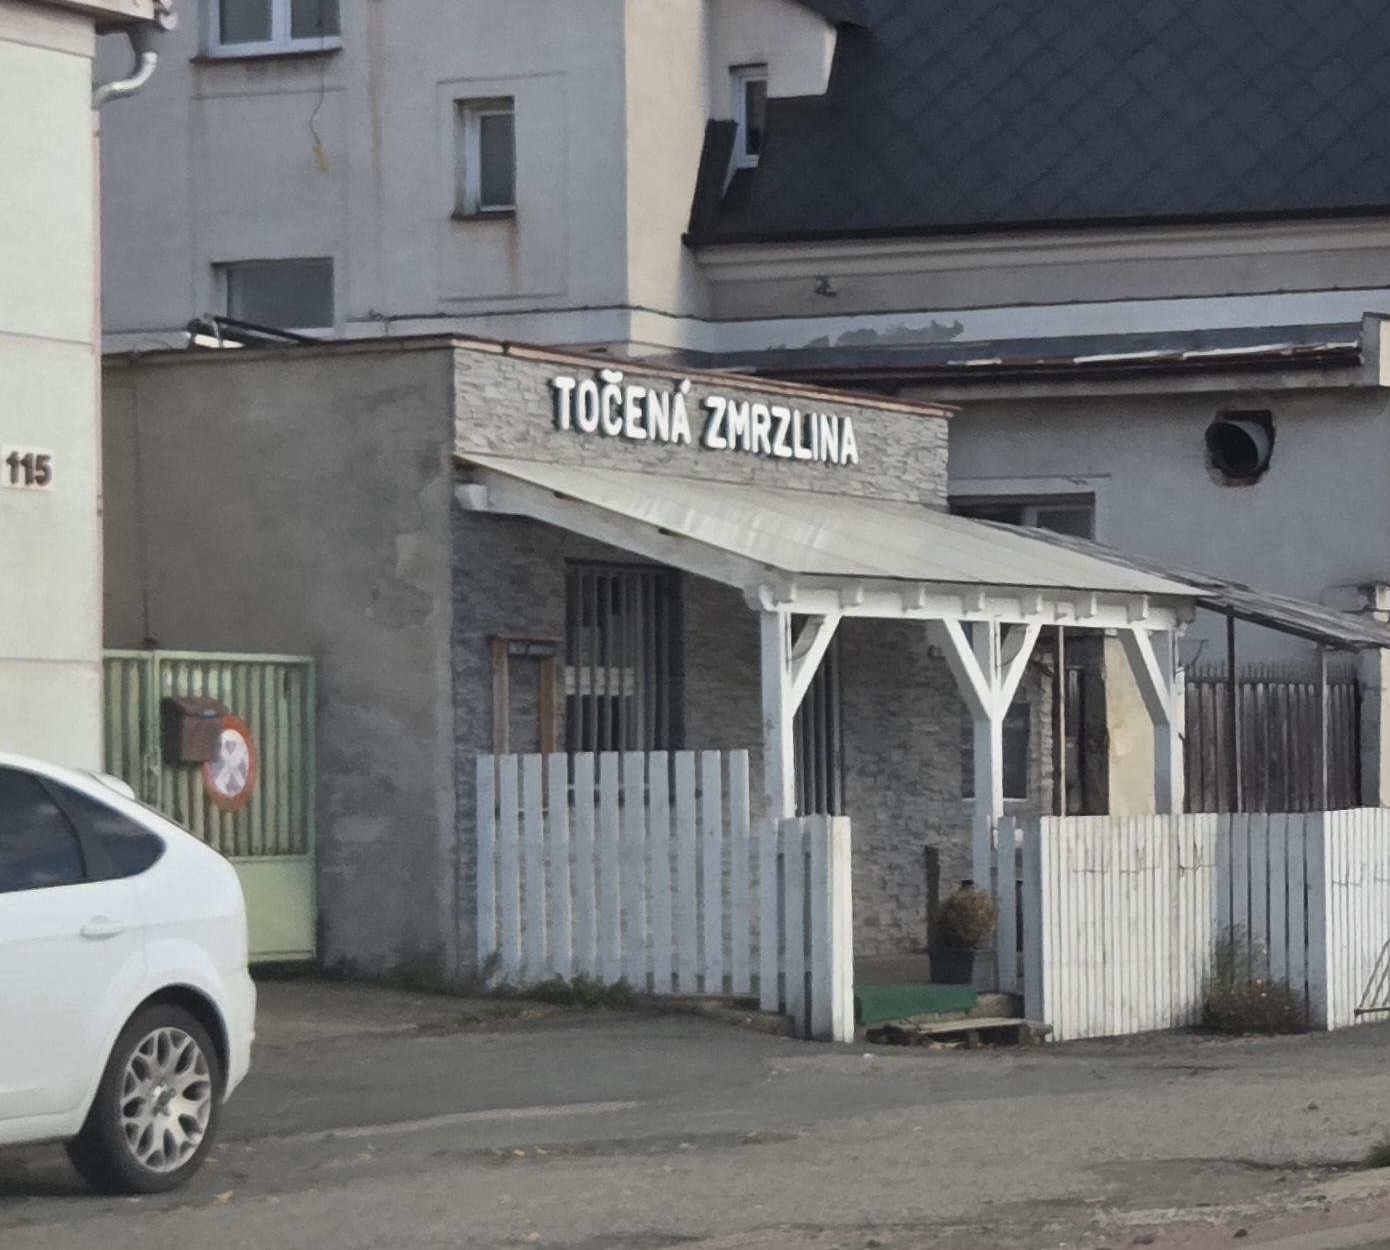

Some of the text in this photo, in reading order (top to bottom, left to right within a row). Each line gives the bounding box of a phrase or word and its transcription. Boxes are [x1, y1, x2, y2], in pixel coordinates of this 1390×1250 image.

[553, 368, 860, 465] TOČENÁ ZMRZLINA
[6, 450, 52, 486] 115
